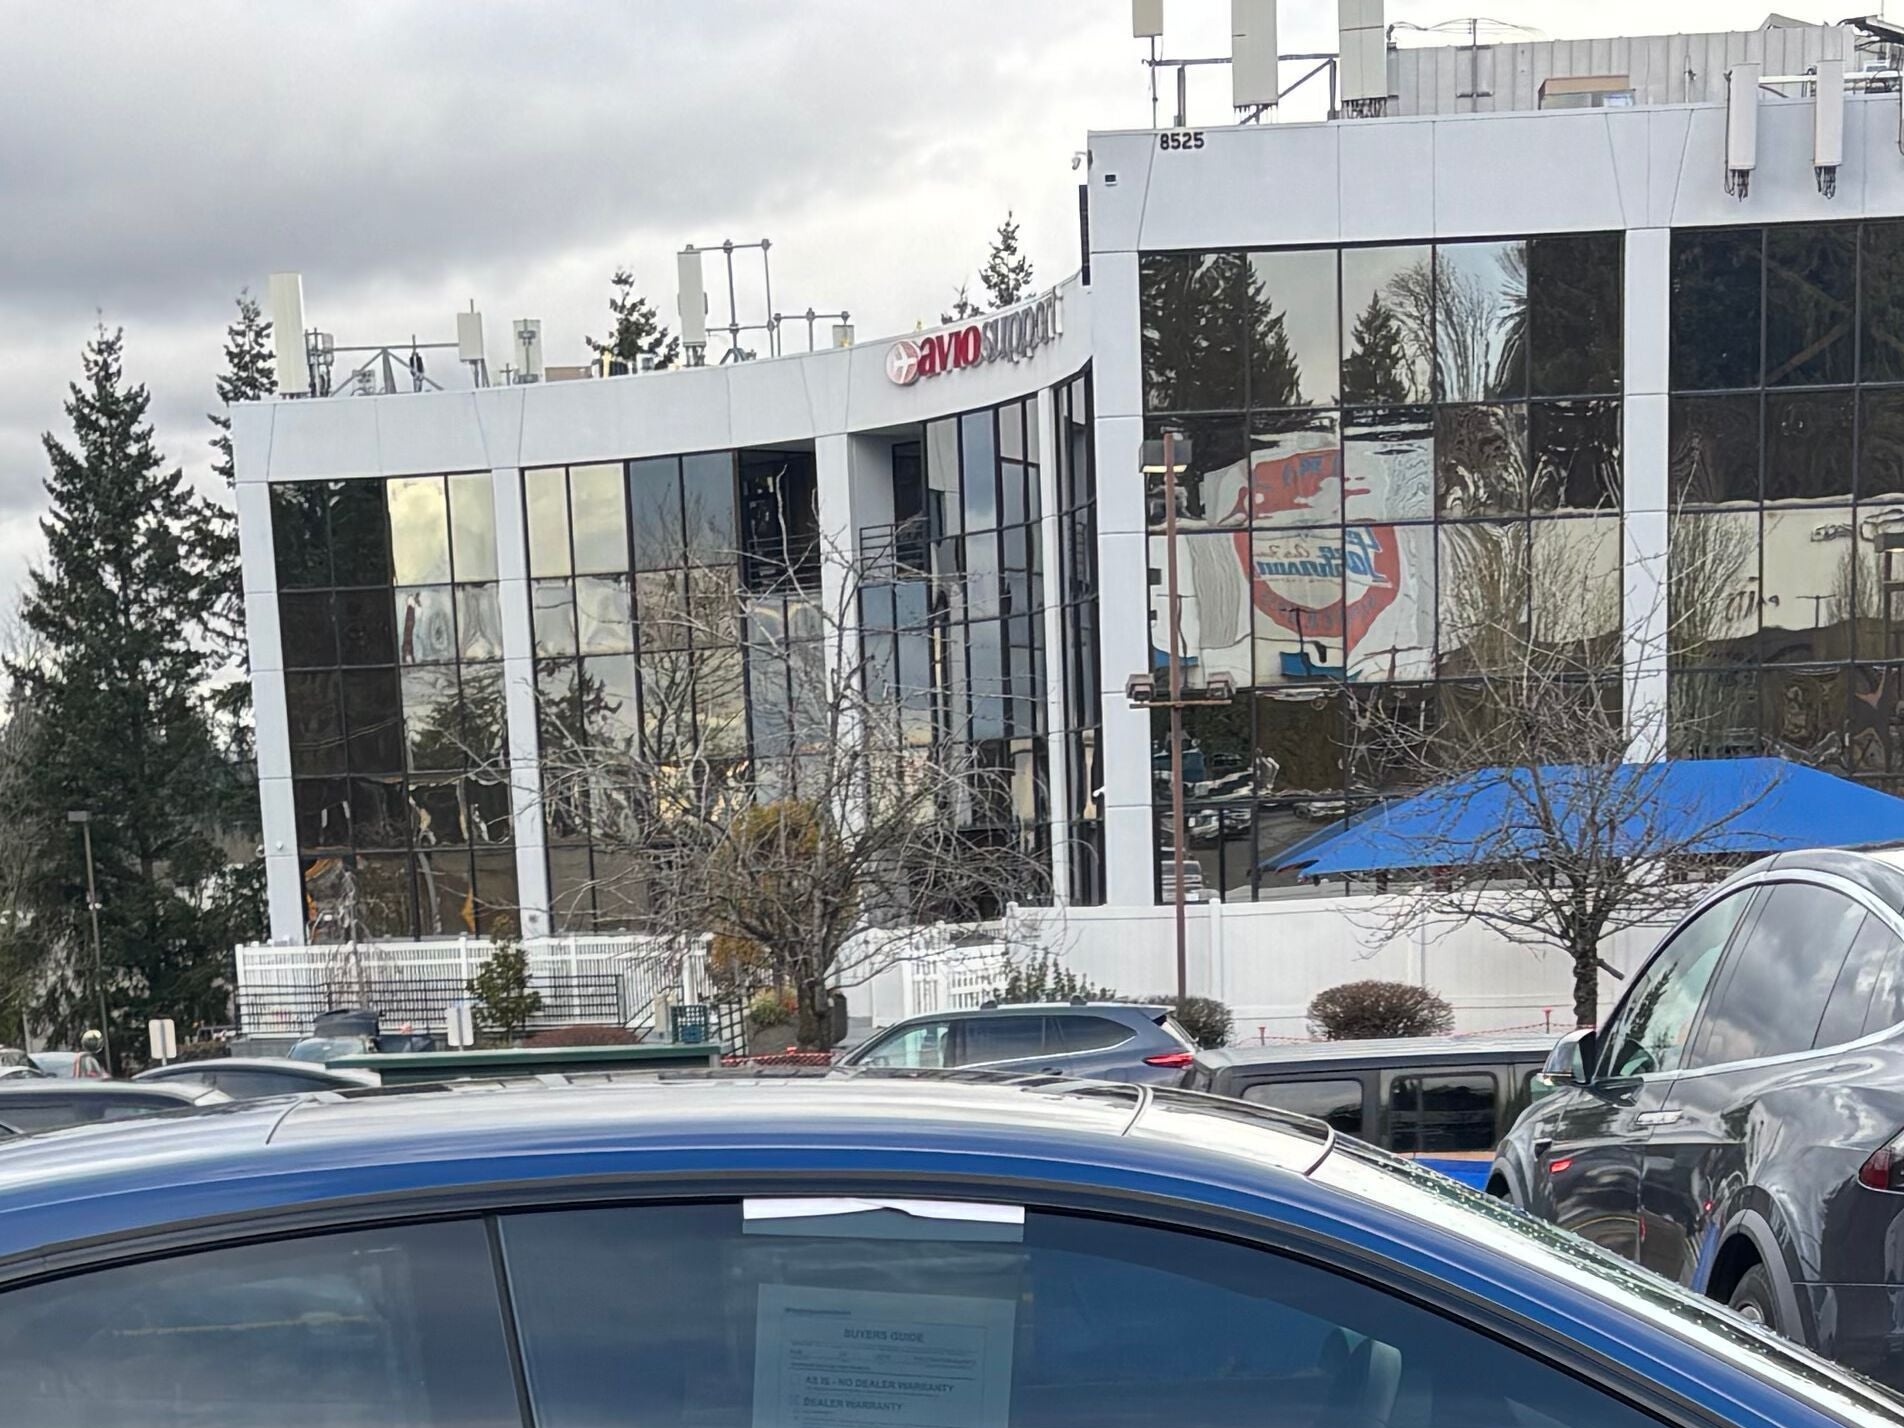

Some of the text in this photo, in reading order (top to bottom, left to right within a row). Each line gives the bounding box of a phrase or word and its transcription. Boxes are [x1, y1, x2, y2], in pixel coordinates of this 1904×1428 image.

[1159, 131, 1205, 150] 8525
[889, 1331, 925, 1343] GUIDE
[854, 1378, 897, 1389] DEALER
[802, 1397, 844, 1409] DEALER
